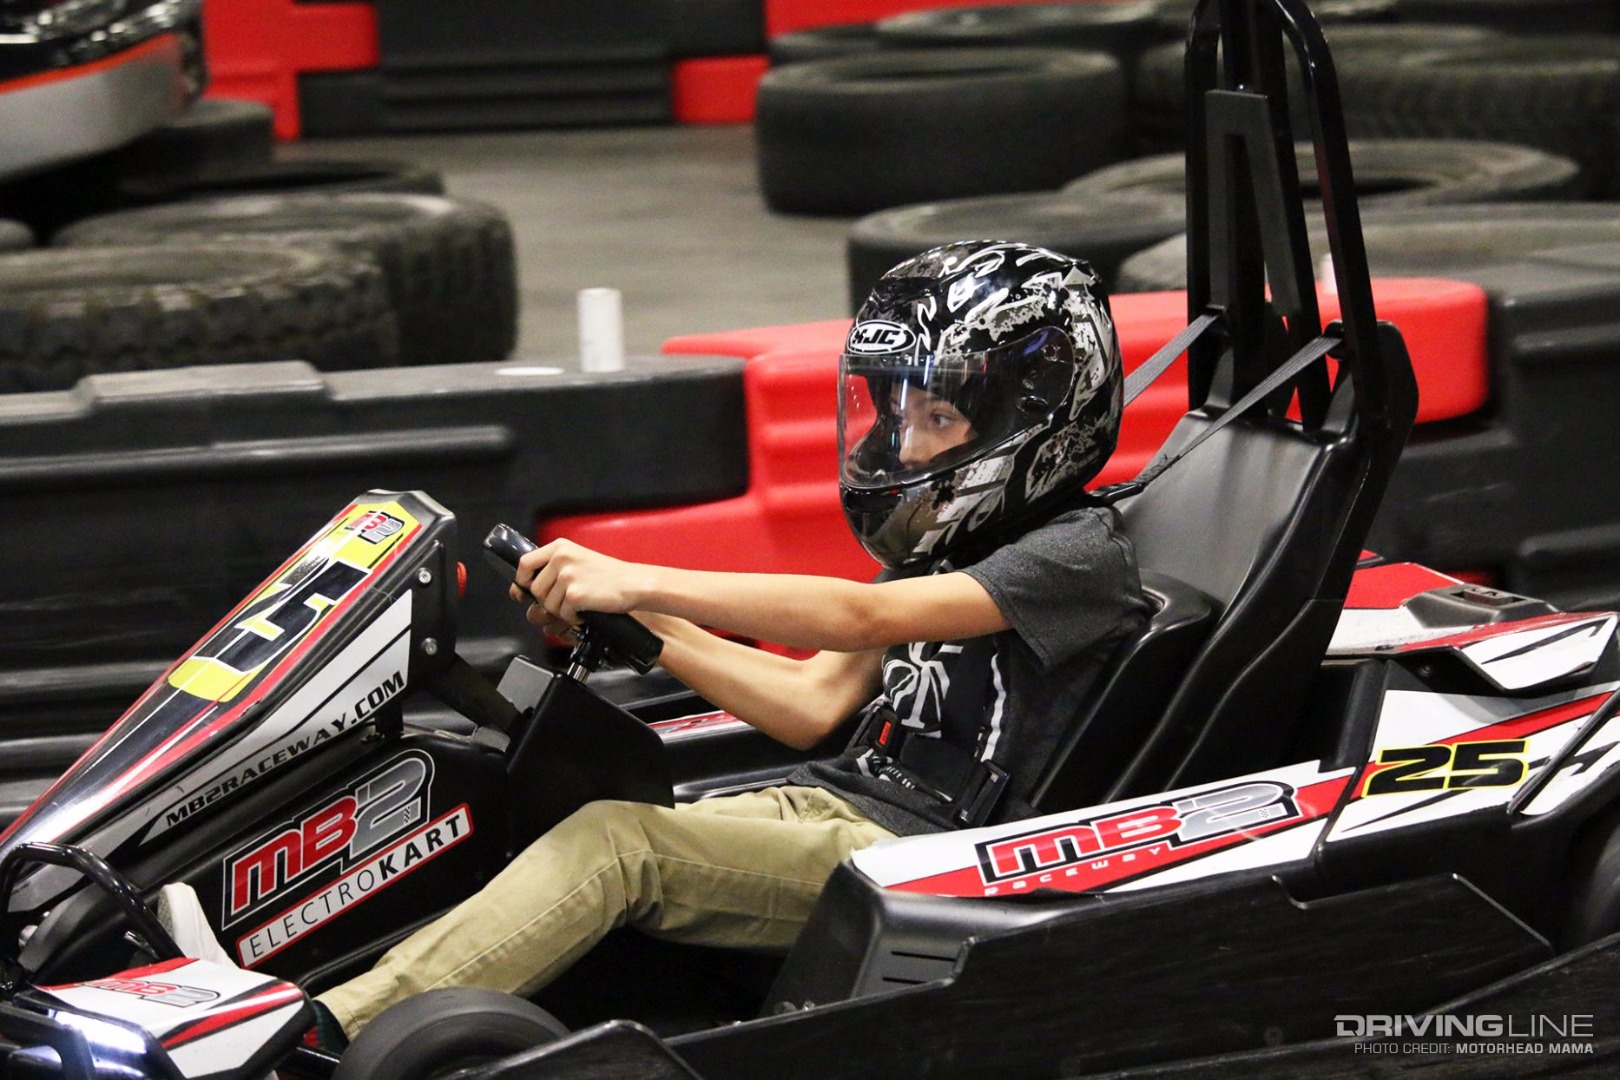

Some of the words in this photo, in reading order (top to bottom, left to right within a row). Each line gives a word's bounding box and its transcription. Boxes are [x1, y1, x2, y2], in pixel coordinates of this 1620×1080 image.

[851, 328, 900, 345] HJC
[165, 670, 405, 828] MB2RACEWAY.COM
[1361, 738, 1529, 798] 25
[230, 754, 429, 917] MB2
[249, 814, 461, 958] ELECTROKART
[985, 784, 1290, 879] MB2
